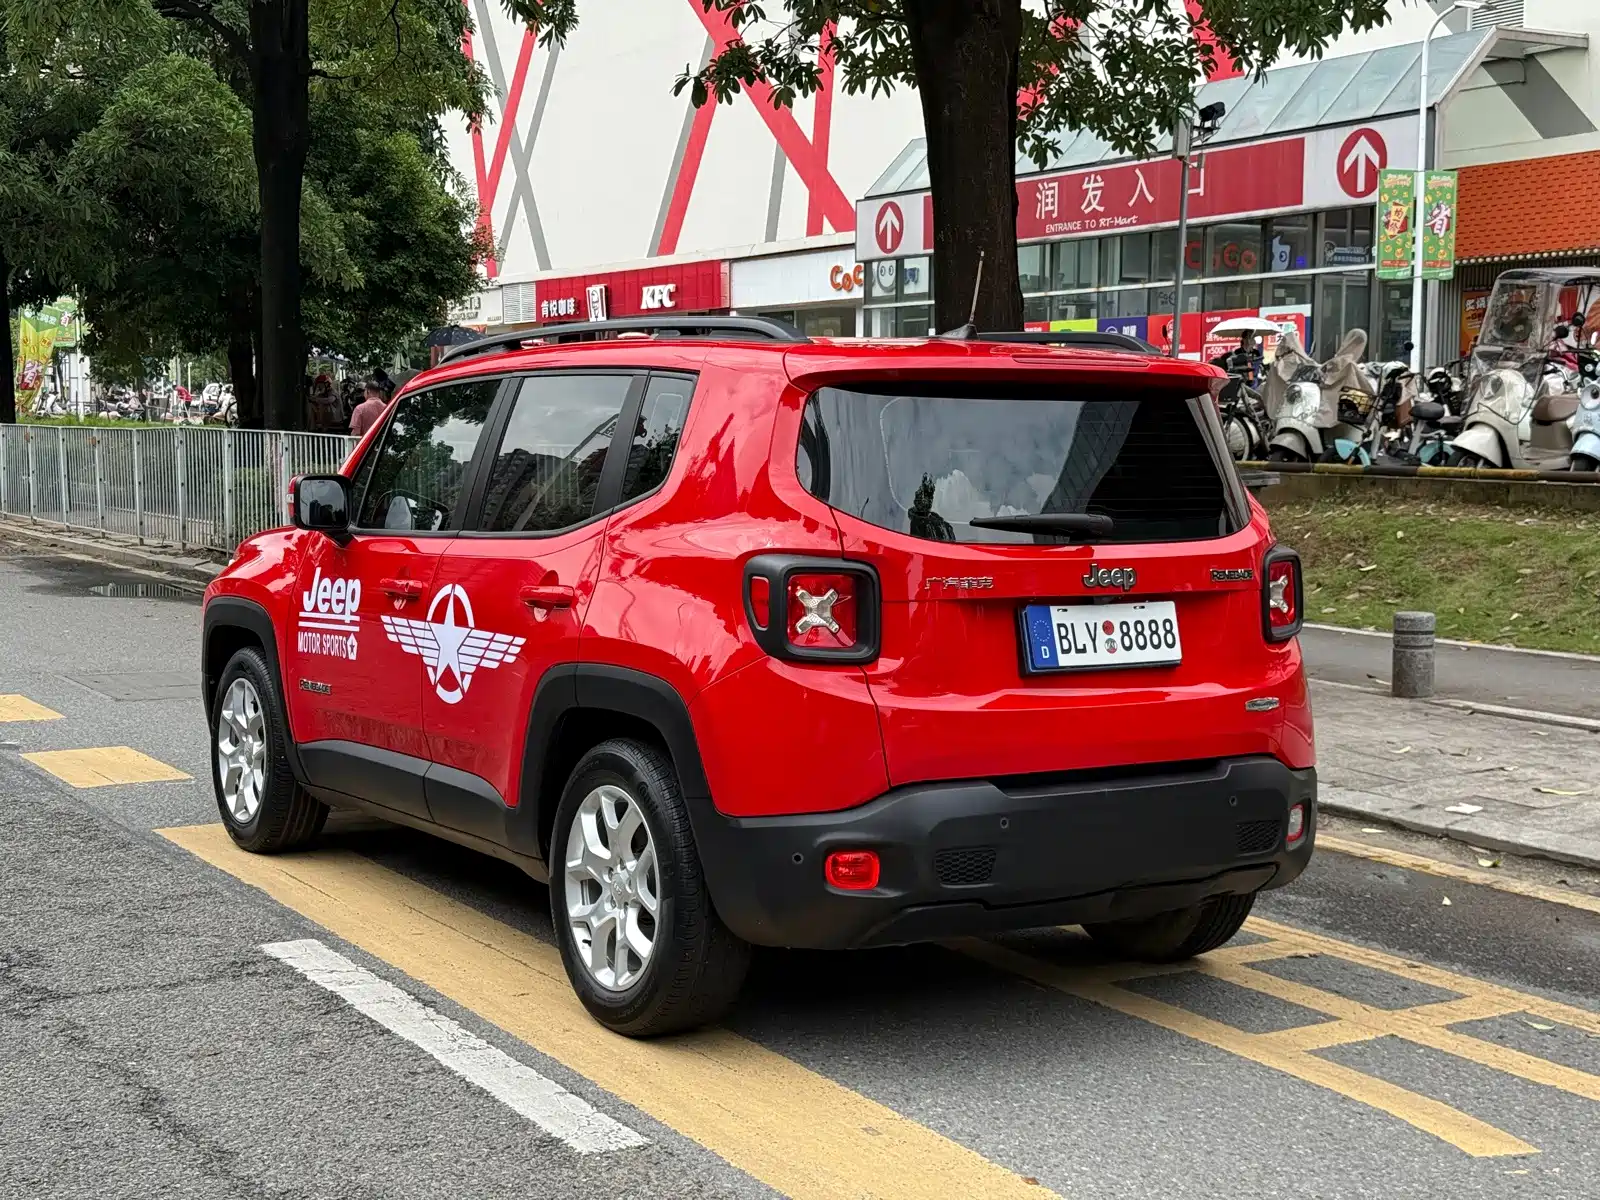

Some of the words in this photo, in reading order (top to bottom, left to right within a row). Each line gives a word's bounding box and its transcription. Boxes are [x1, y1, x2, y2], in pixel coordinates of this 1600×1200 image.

[1045, 220, 1082, 233] ENTRANCE
[1085, 219, 1097, 229] TO
[1099, 214, 1138, 228] RT-Mart
[1424, 200, 1452, 238] 省
[541, 297, 575, 318] 肯悦咖啡
[640, 283, 677, 310] KFC
[1083, 563, 1136, 591] Jeep
[303, 566, 361, 623] Jeep
[297, 631, 321, 655] MOTOR
[322, 633, 347, 659] SPORTS
[1041, 645, 1050, 659] D
[1056, 621, 1098, 655] BLY
[1118, 618, 1177, 652] 8888
